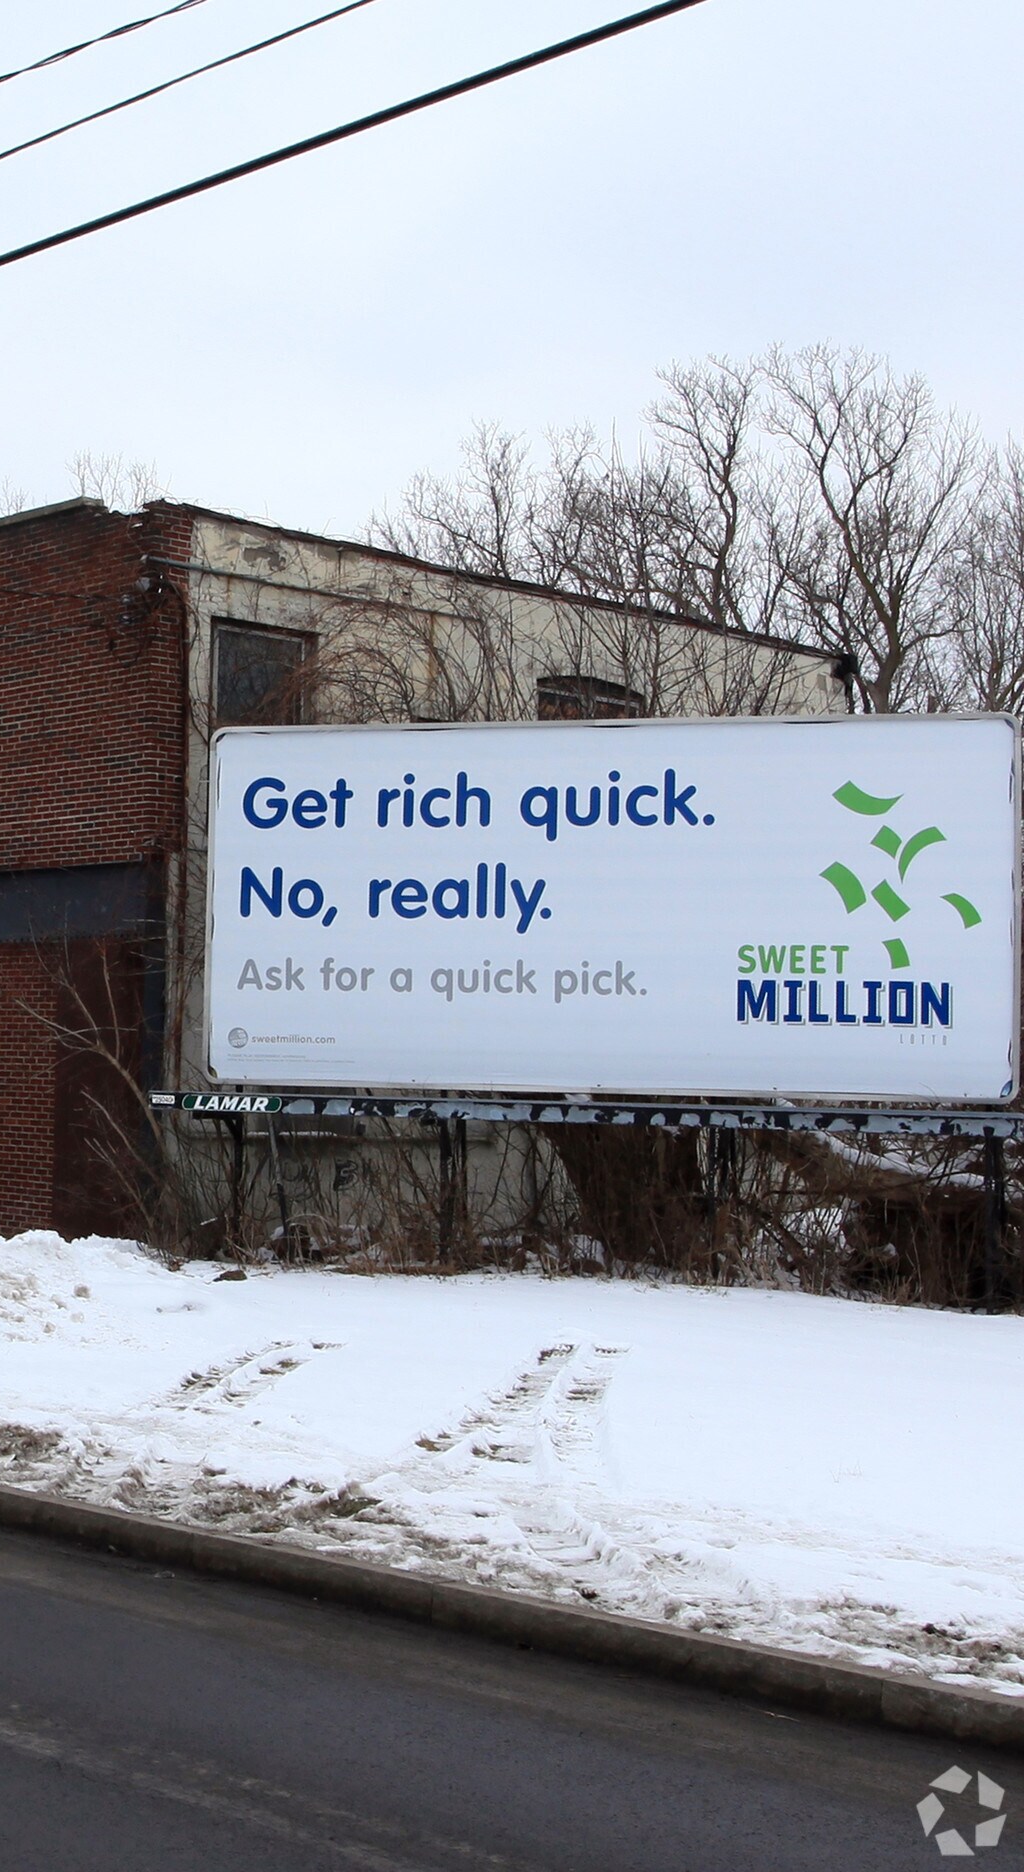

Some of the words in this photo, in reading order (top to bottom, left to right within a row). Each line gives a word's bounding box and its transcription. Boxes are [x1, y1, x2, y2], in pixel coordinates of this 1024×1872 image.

[243, 777, 353, 829] Get
[377, 771, 491, 828] rich
[520, 768, 715, 841] quick.
[240, 866, 338, 927] No,
[368, 862, 552, 934] really.
[737, 944, 849, 974] SWEET
[237, 957, 306, 991] Ask
[320, 957, 375, 992] for
[390, 967, 413, 993] a
[431, 959, 537, 1002] quick
[554, 960, 648, 1003] pick.
[736, 979, 953, 1030] MILLION
[251, 1033, 336, 1045] sweetmillion.com
[899, 1033, 947, 1046] LOTTO
[193, 1095, 269, 1112] LAMAR
